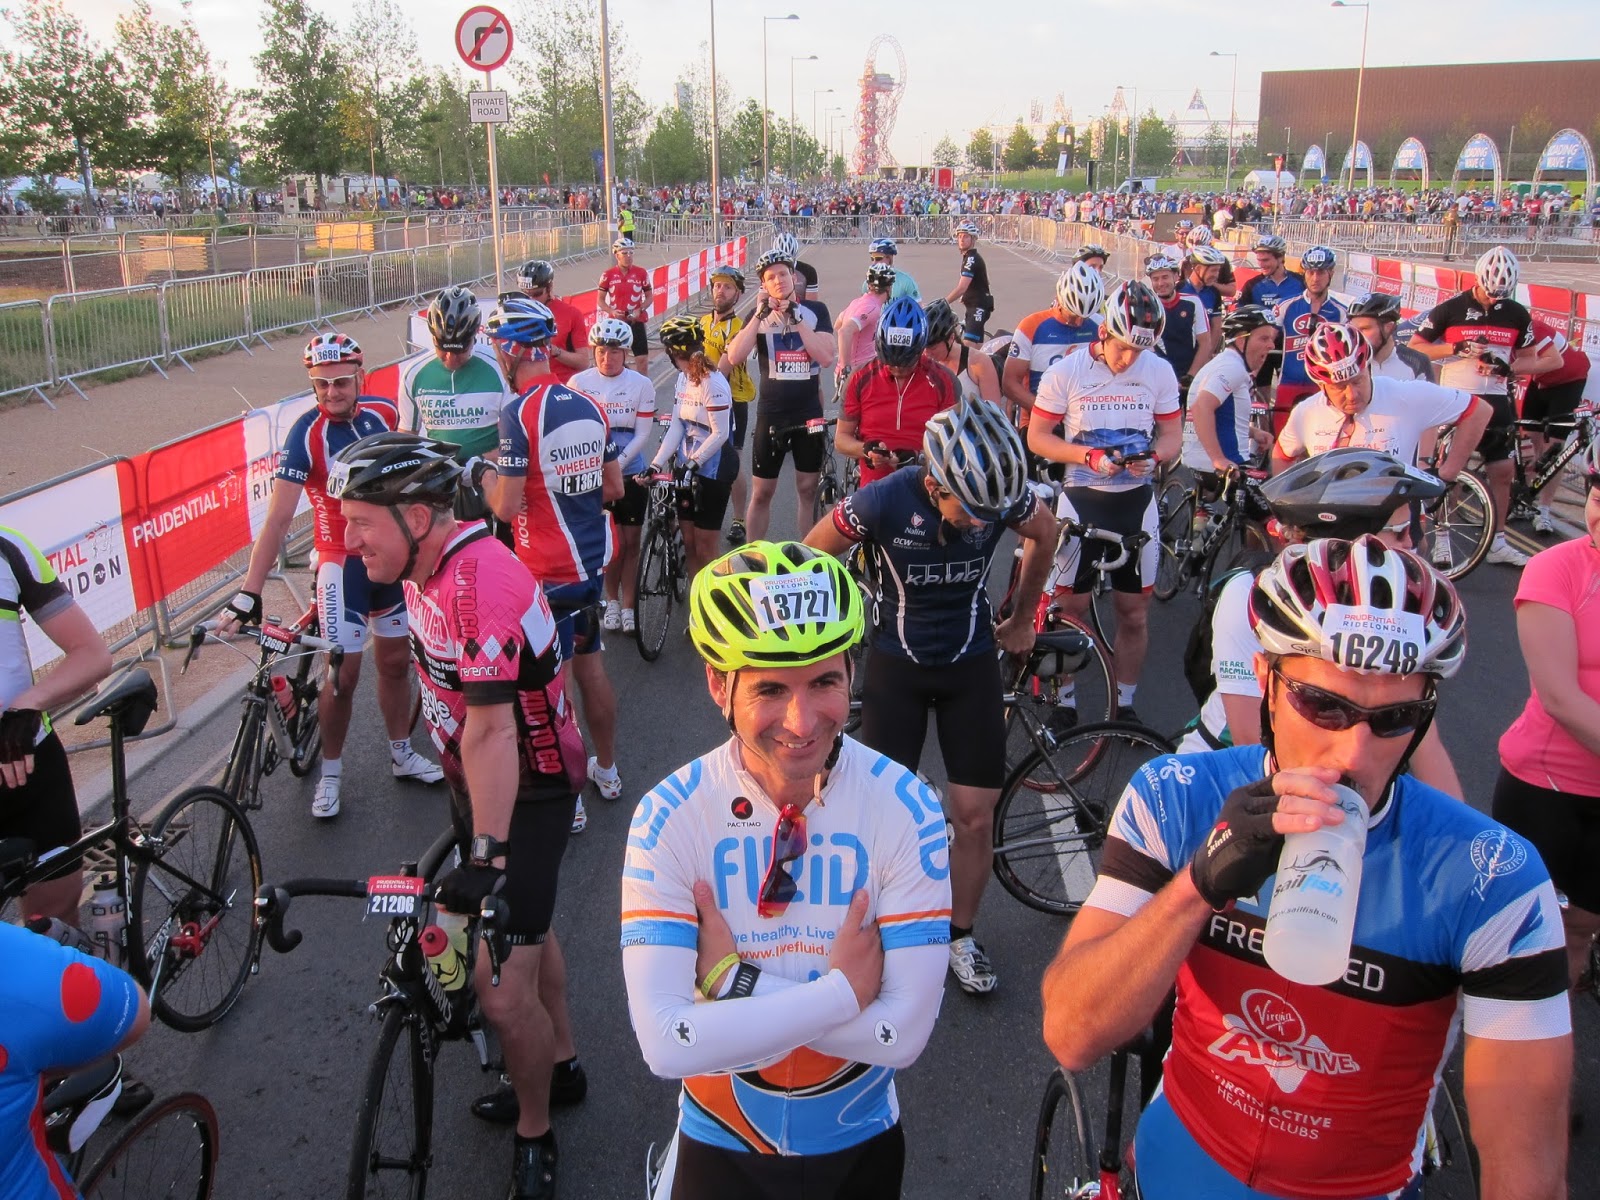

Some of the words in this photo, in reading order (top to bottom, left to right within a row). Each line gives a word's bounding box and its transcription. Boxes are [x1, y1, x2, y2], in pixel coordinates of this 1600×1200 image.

[472, 97, 504, 106] PRIVATE
[477, 108, 501, 116] ROAD
[1487, 330, 1512, 338] ACTIVE
[777, 361, 783, 373] C
[434, 399, 456, 408] ARE
[1080, 395, 1136, 403] PRUDENTIAL
[1080, 403, 1150, 411] RIDELONDON
[446, 418, 480, 426] SUPPORT
[393, 458, 421, 471] GIRO
[131, 489, 221, 548] PRUDENTIAL
[904, 526, 927, 536] Nalini
[764, 576, 808, 586] PRUDENTIAL
[765, 580, 819, 591] RIDELONDON
[325, 583, 339, 643] SWINDON
[760, 589, 830, 625] 13727
[1343, 613, 1396, 624] PRUDENTIAL
[1342, 621, 1408, 634] RIDELONDON
[260, 634, 288, 653] 13686
[1330, 631, 1419, 676] 16248
[1229, 660, 1245, 668] ARE
[1207, 828, 1233, 857] skinfit
[1273, 873, 1343, 898] sailfish
[371, 895, 415, 914] 21206
[806, 928, 835, 940] Live
[1254, 999, 1295, 1036] Virgin
[1207, 1027, 1360, 1075] ACTIVE
[1217, 1085, 1265, 1123] HEALTH
[1268, 1105, 1332, 1128] ACTIVE
[1268, 1116, 1320, 1140] CLUBS
